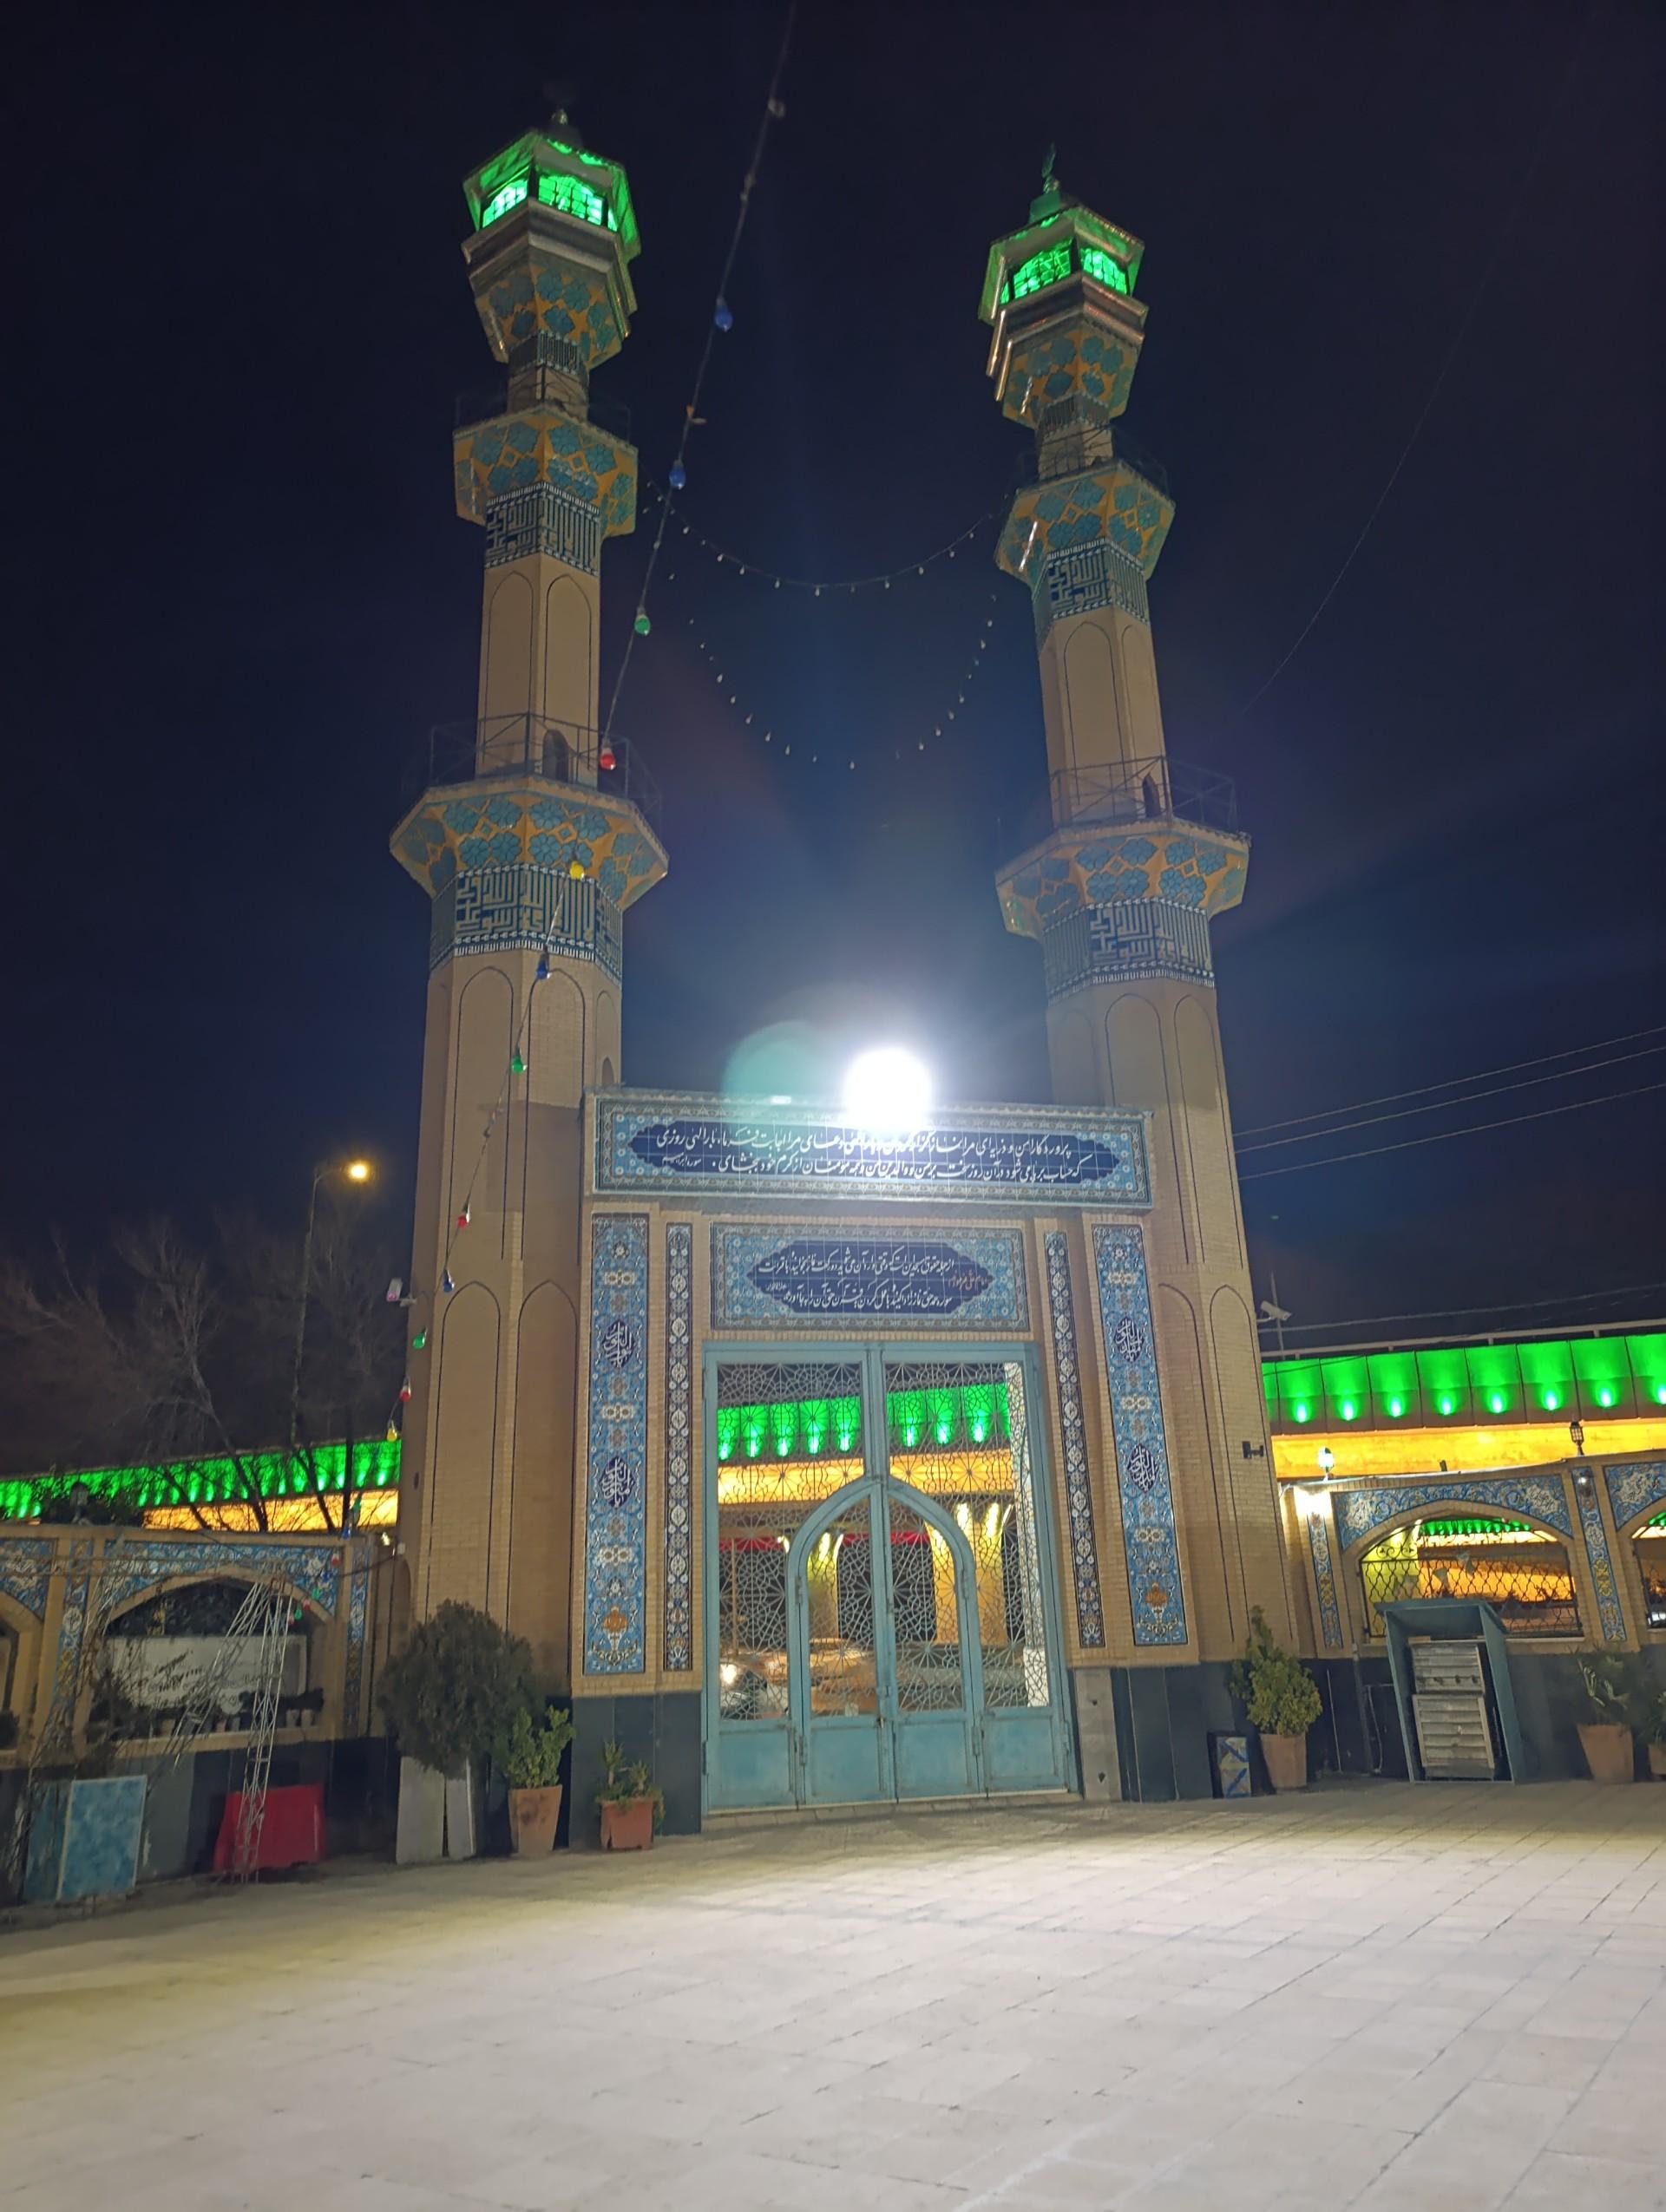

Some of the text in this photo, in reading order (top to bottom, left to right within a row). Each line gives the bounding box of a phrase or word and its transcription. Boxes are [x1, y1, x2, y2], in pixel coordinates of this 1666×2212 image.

[657, 1129, 685, 1148] روزی
[751, 1131, 785, 1153] اجابت
[785, 1130, 801, 1151] مرا
[962, 1136, 975, 1156] مرا
[1030, 1133, 1072, 1159] پروردگارا
[1015, 1141, 1030, 1157] من
[760, 1154, 777, 1172] خود
[775, 1150, 799, 1175] کرم
[793, 1157, 803, 1173] از
[915, 1162, 929, 1180] من
[928, 1163, 937, 1179] بر
[936, 1160, 971, 1177] سخت
[967, 1163, 983, 1179] روز
[1072, 1154, 1093, 1177] که
[1043, 1164, 1072, 1182] حساب
